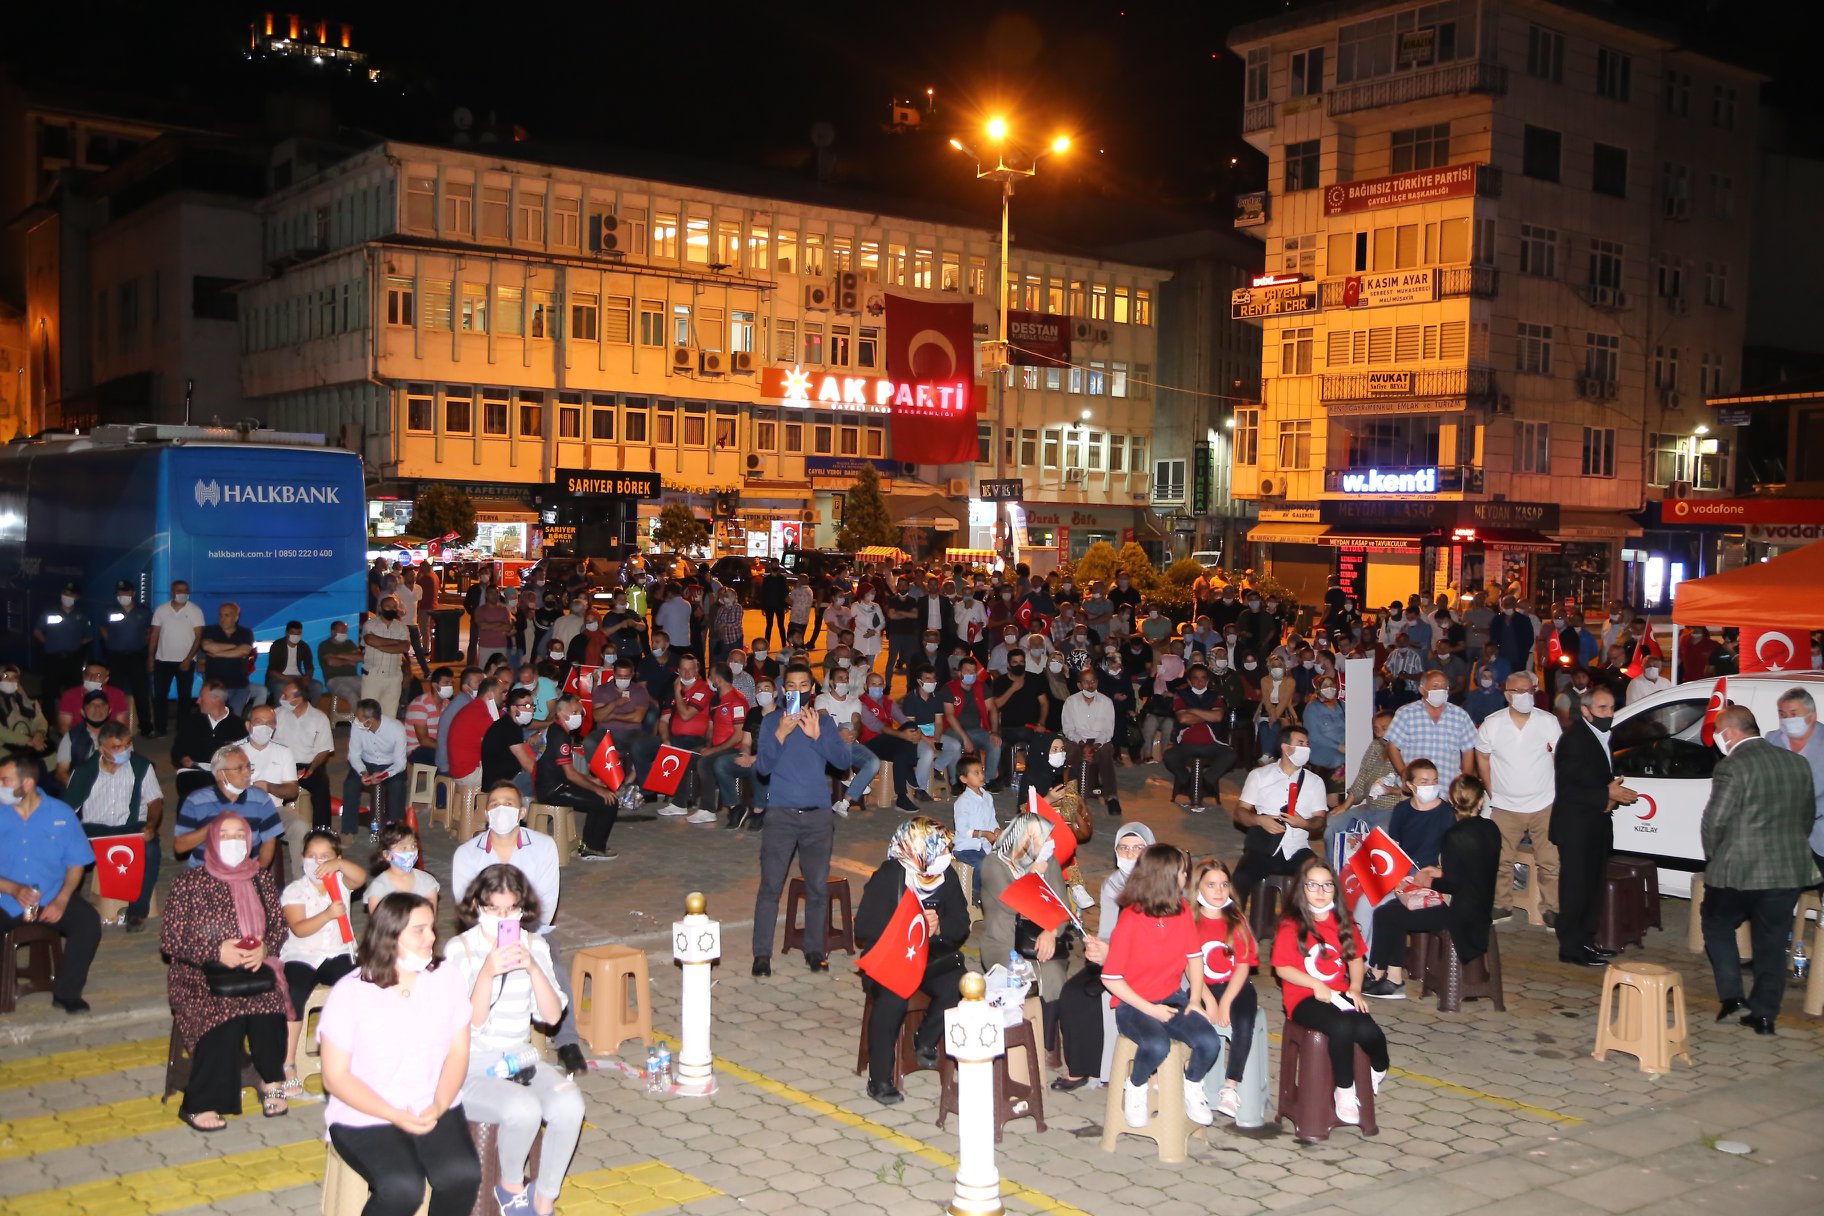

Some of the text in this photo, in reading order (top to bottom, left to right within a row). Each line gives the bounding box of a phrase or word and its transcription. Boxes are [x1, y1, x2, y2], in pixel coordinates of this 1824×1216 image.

[1349, 166, 1472, 199] BAĞIMSIZ TÜRKİYE PARTİSİ
[1367, 187, 1449, 207] ÇAYELİ İLÇE BAŞKANLIĞI
[1367, 273, 1428, 290] KASIM AYAR
[1264, 283, 1302, 301] ÇAYELİ
[1370, 289, 1393, 297] SERBEST
[1240, 298, 1308, 317] RENT A CAR
[1011, 321, 1059, 337] DESTAN
[1369, 373, 1409, 383] AVUKAT
[818, 376, 964, 410] AK PARTİ
[1397, 402, 1419, 410] EMLAK
[568, 477, 651, 495] SARIYER BÖREK
[1343, 468, 1436, 493] w.kenti
[224, 484, 340, 504] HALKBANK
[465, 486, 531, 496] KAFETERYA
[981, 483, 1021, 497] EVET
[1338, 502, 1386, 518] MEYDAN
[1474, 504, 1544, 520] MEYDAN KASAP
[1692, 503, 1744, 514] vodafone
[1027, 510, 1060, 524] Durak
[1071, 510, 1097, 526] Büfe
[545, 526, 576, 534] SARIYER
[1765, 524, 1824, 538] vodaf
[1329, 538, 1350, 546] MEYDAN
[208, 549, 333, 558] halkbank.com.tr 0850 222 0 400
[1633, 825, 1658, 833] KIZILAY
